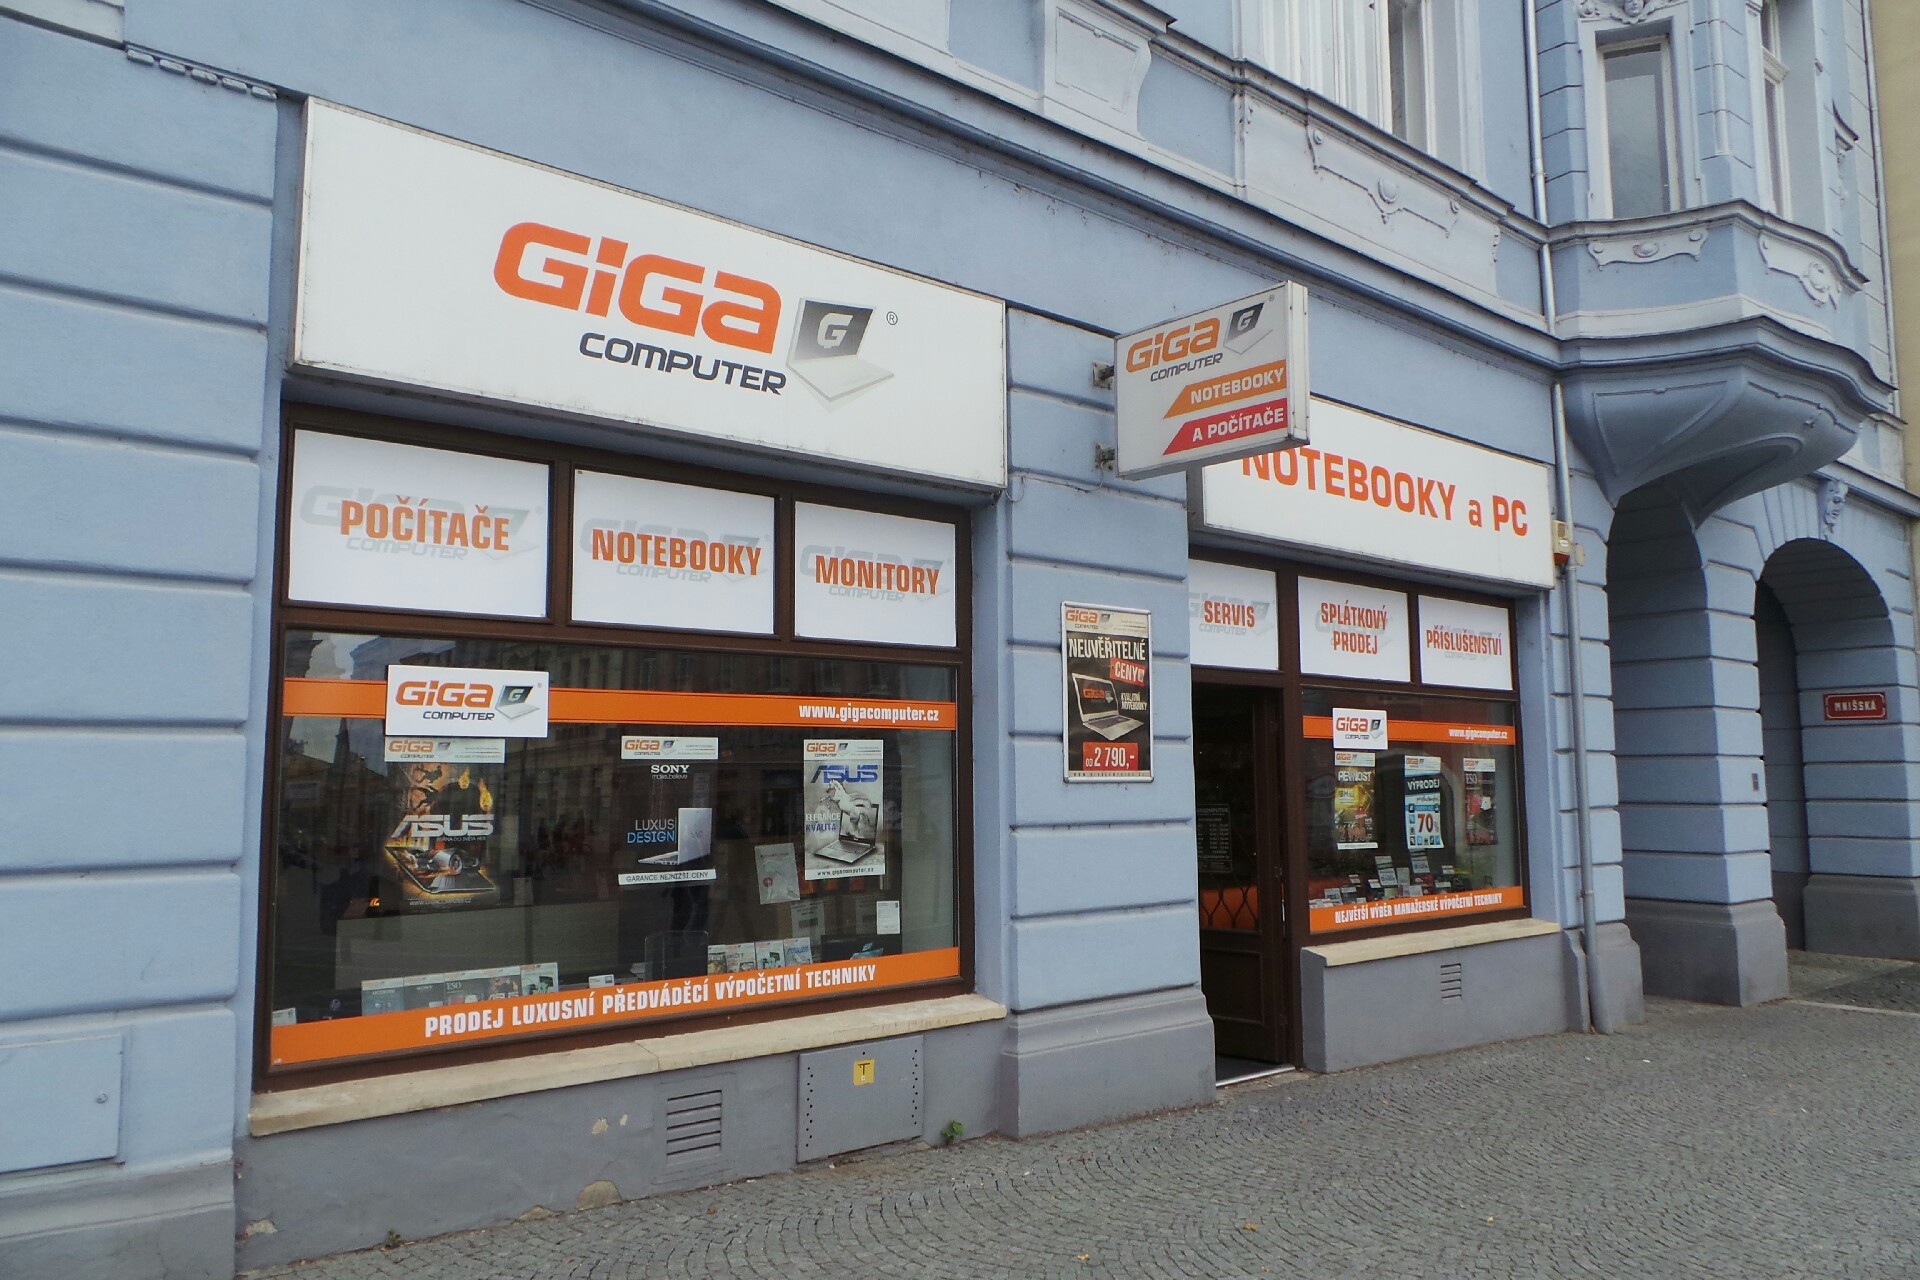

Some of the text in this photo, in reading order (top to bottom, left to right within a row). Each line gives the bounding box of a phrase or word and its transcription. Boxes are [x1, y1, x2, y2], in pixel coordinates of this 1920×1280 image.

[579, 333, 786, 395] COMPUTER
[1150, 352, 1223, 381] COMPUTER
[1190, 368, 1284, 404] NOTEBOOKY
[1193, 407, 1284, 442] A POČÍTAČE
[340, 494, 510, 551] POČÍTAČE
[1468, 499, 1483, 528] a
[1492, 495, 1528, 537] PC
[346, 537, 468, 560] COMPUTER
[592, 528, 762, 576] NOTEBOOKY
[616, 563, 712, 584] COMPUTER
[815, 554, 940, 595] MONITORY
[1203, 600, 1256, 628] SERVIS
[1320, 600, 1387, 630] SPLÁTKOVÝ
[1199, 623, 1247, 636] COMPUTER
[1426, 624, 1502, 656] PŘÍSLUŠENSTVÍ
[1068, 636, 1146, 660] NEUVĚŘITELNÉ
[1333, 632, 1378, 655] PRODEJ
[423, 710, 495, 721] COMPUTER
[799, 702, 939, 723] www.gigacomputer.cz
[650, 764, 690, 774] SONY
[810, 764, 879, 784] ASUS
[1338, 770, 1372, 782] PEVNOST
[1407, 778, 1440, 791] VÝPRODEJ
[390, 814, 495, 838] ASUS
[635, 819, 675, 831] LUXUS
[805, 823, 837, 832] KVALITA
[806, 812, 841, 821] ELEGANCE
[1417, 813, 1434, 833] 70
[627, 831, 675, 844] DESIGN
[626, 874, 658, 882] GARANCE
[1335, 892, 1503, 923] NEJVĚTŠÍ VÝBĚR MANAŽERSKÉ VÝPOČETNÍ TECHNIKY
[424, 964, 876, 1038] PRODEJ LUXUSNÍ PŘEDVÁDĚCÍ VÝPOČETNÍ TECHNIKY
